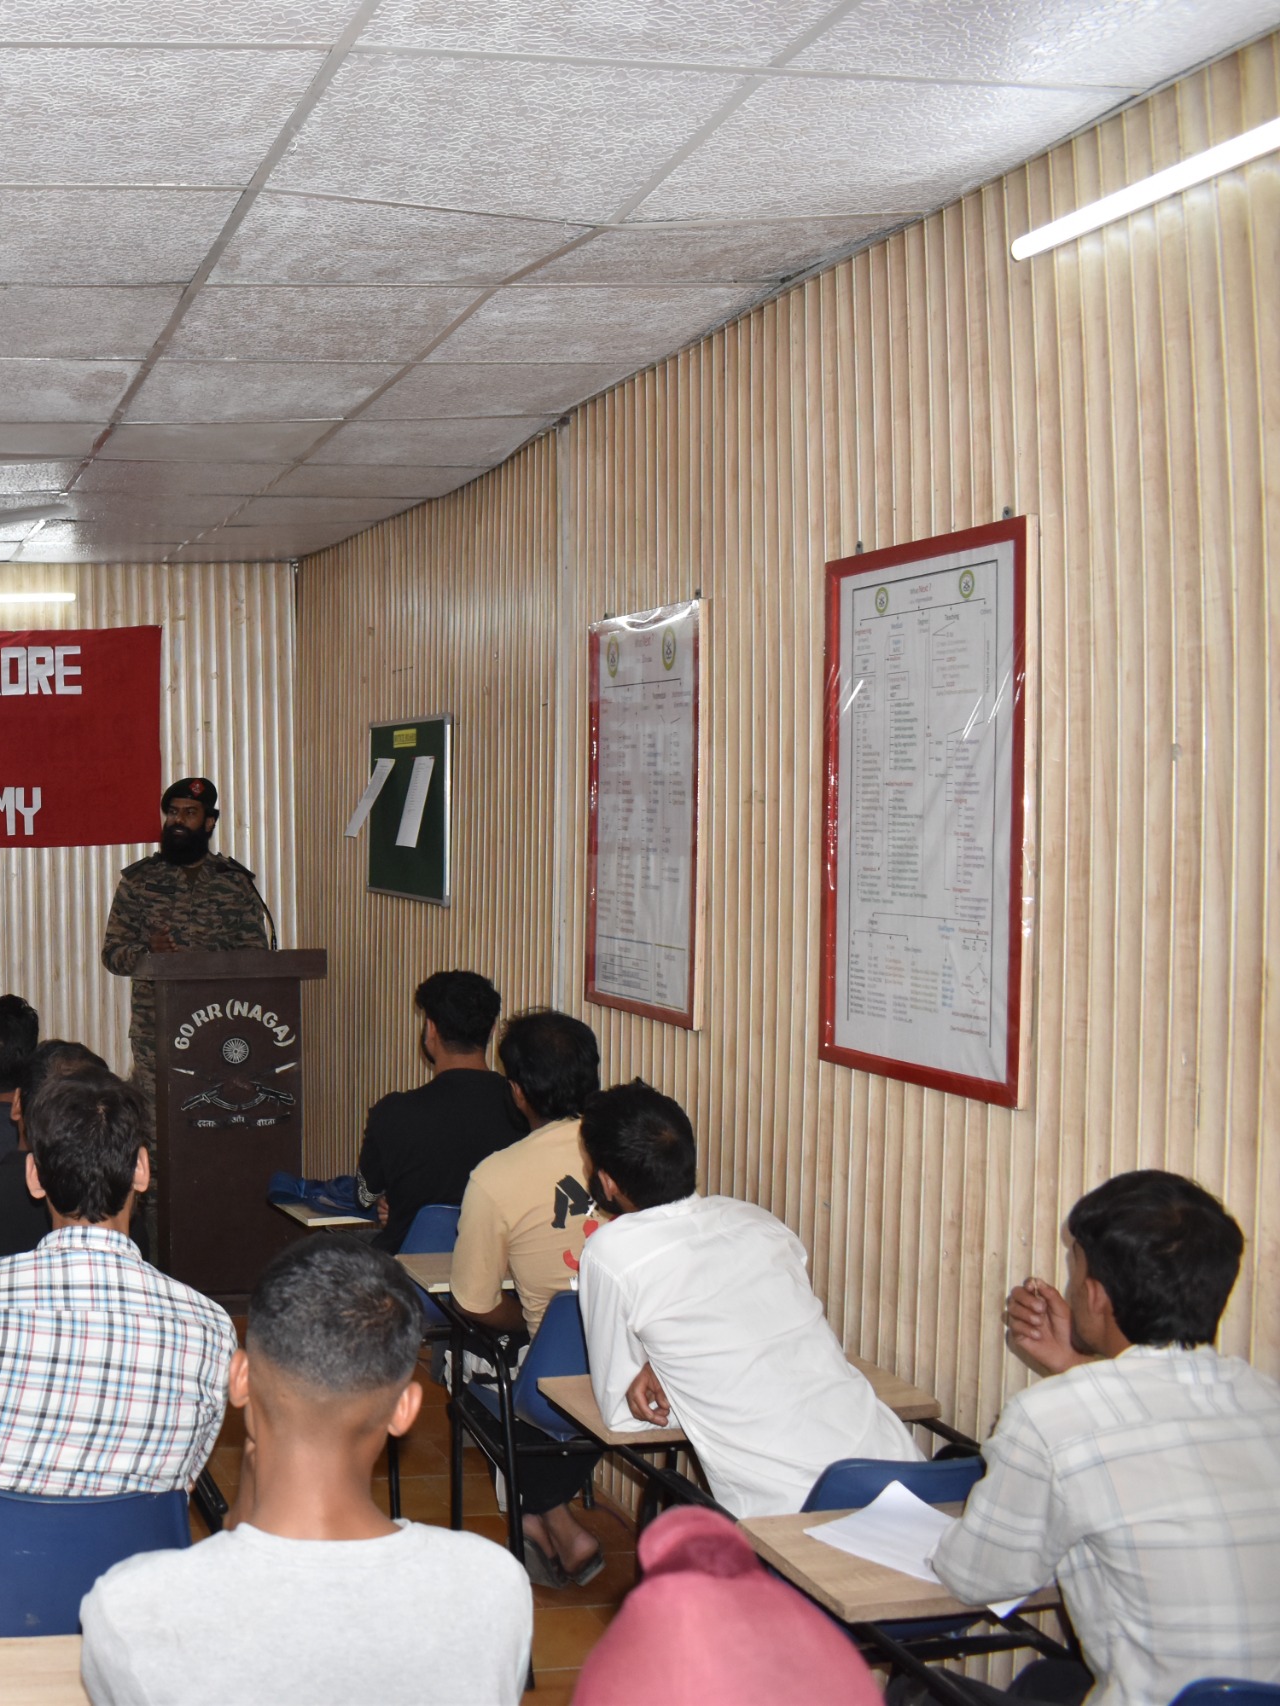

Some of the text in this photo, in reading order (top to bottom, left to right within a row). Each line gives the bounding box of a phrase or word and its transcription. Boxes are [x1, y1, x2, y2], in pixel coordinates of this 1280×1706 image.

[174, 998, 296, 1050] 60 RR (NAGA)
